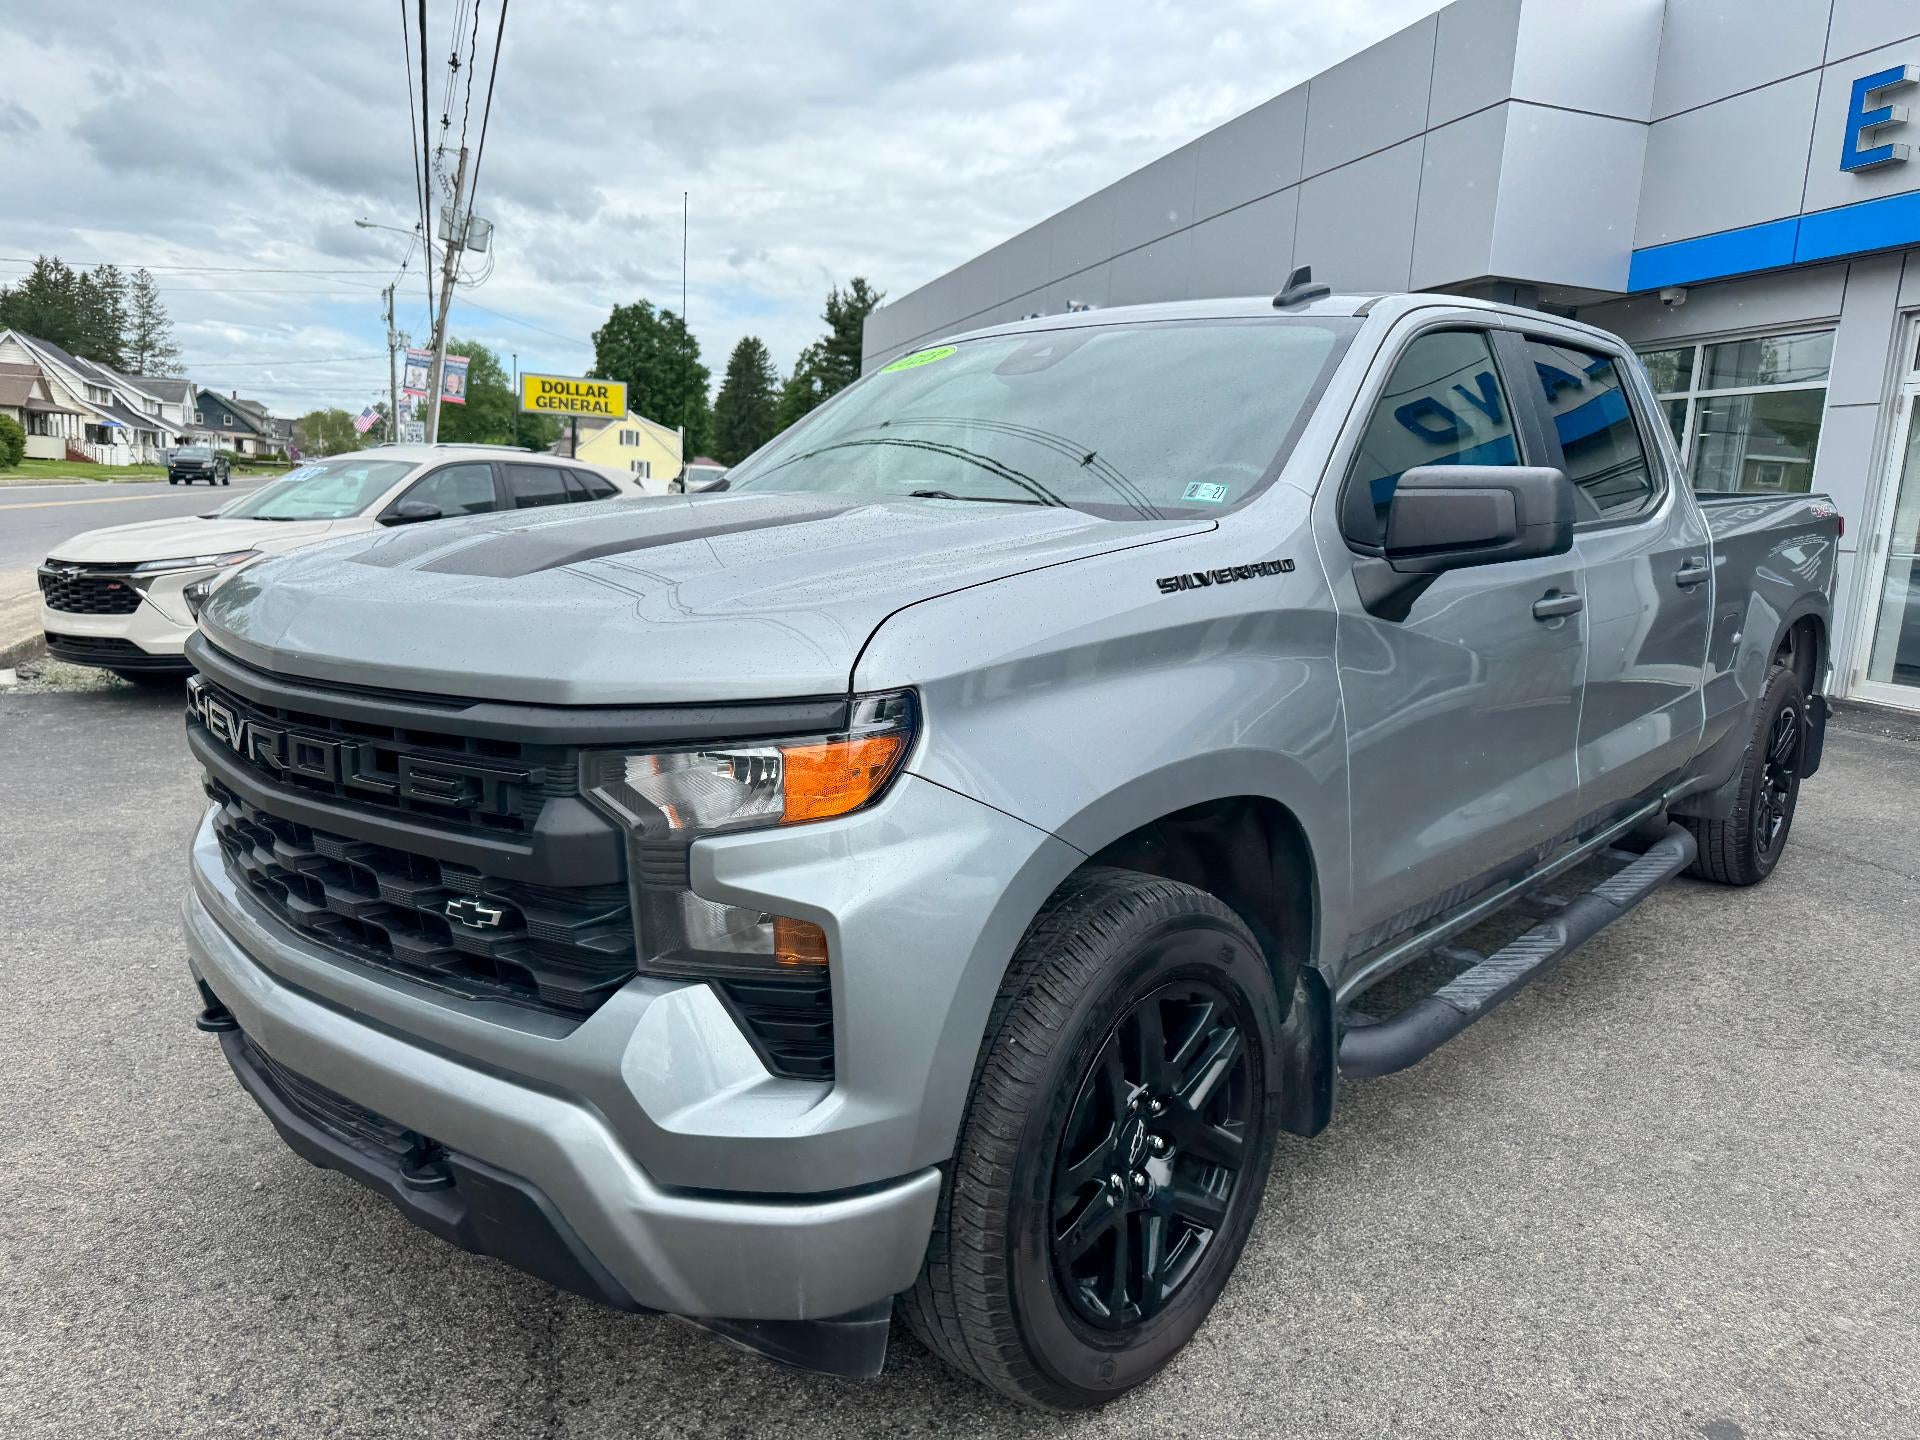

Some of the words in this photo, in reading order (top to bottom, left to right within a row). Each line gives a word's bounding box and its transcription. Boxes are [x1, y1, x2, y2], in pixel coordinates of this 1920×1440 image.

[541, 380, 609, 399] DOLLAR
[536, 395, 614, 414] GENERAL
[1212, 486, 1226, 500] 27
[1156, 558, 1296, 595] SILVERADO
[186, 675, 546, 816] CHEVROLET
